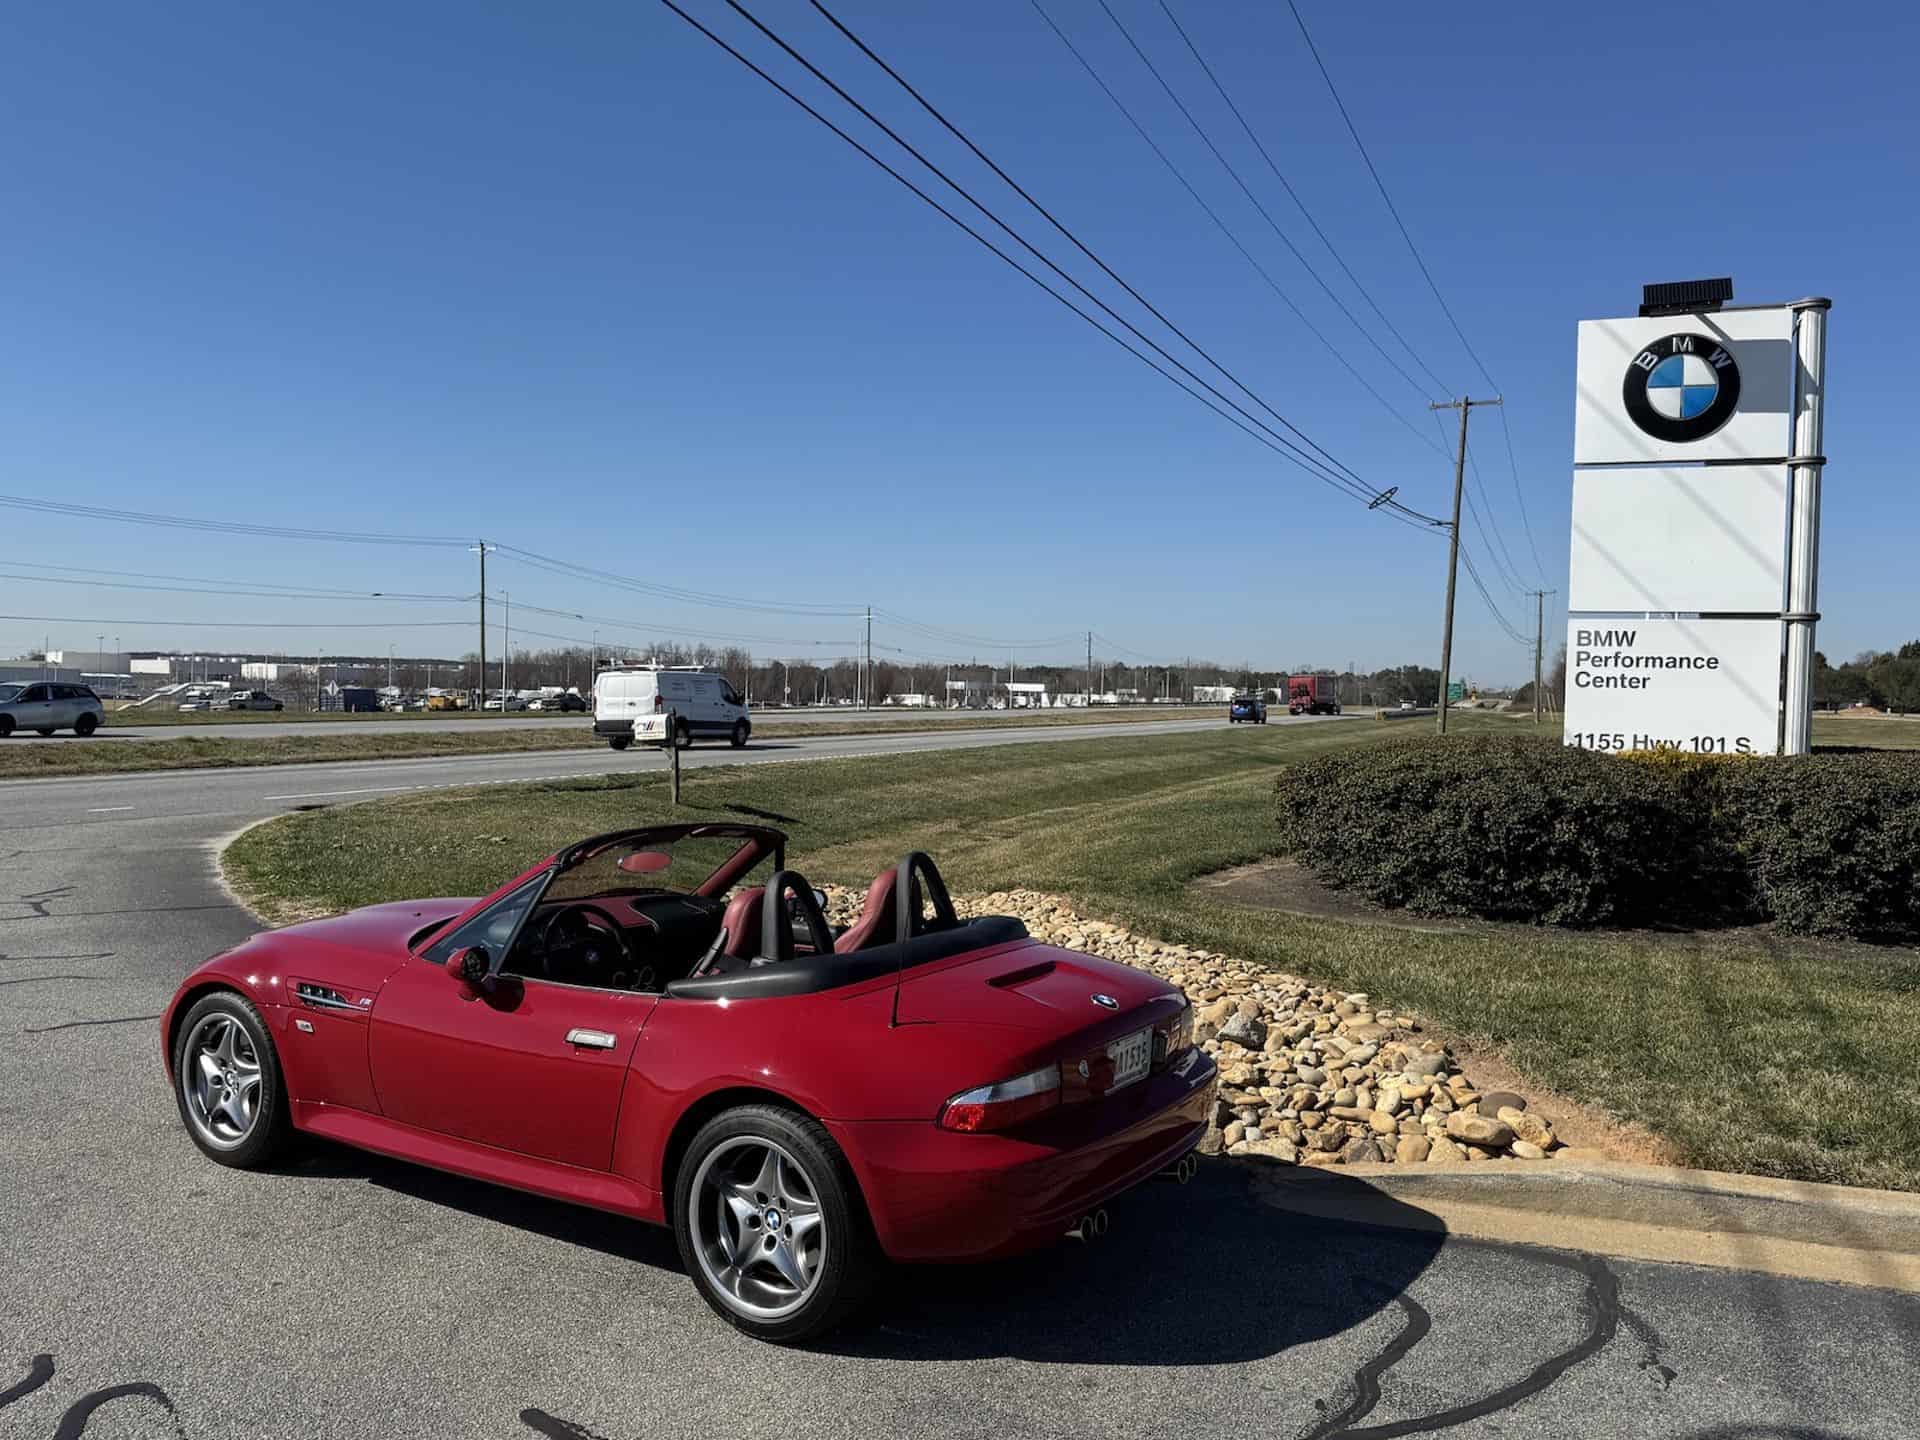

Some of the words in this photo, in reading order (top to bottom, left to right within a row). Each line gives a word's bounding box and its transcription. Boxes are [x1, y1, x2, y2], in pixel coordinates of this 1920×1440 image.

[1633, 336, 1732, 371] BMW
[1576, 630, 1636, 647] BMW
[1575, 651, 1719, 670] Performance
[1575, 671, 1651, 689] Center
[1574, 732, 1625, 750] 1155
[1690, 736, 1726, 753] 101
